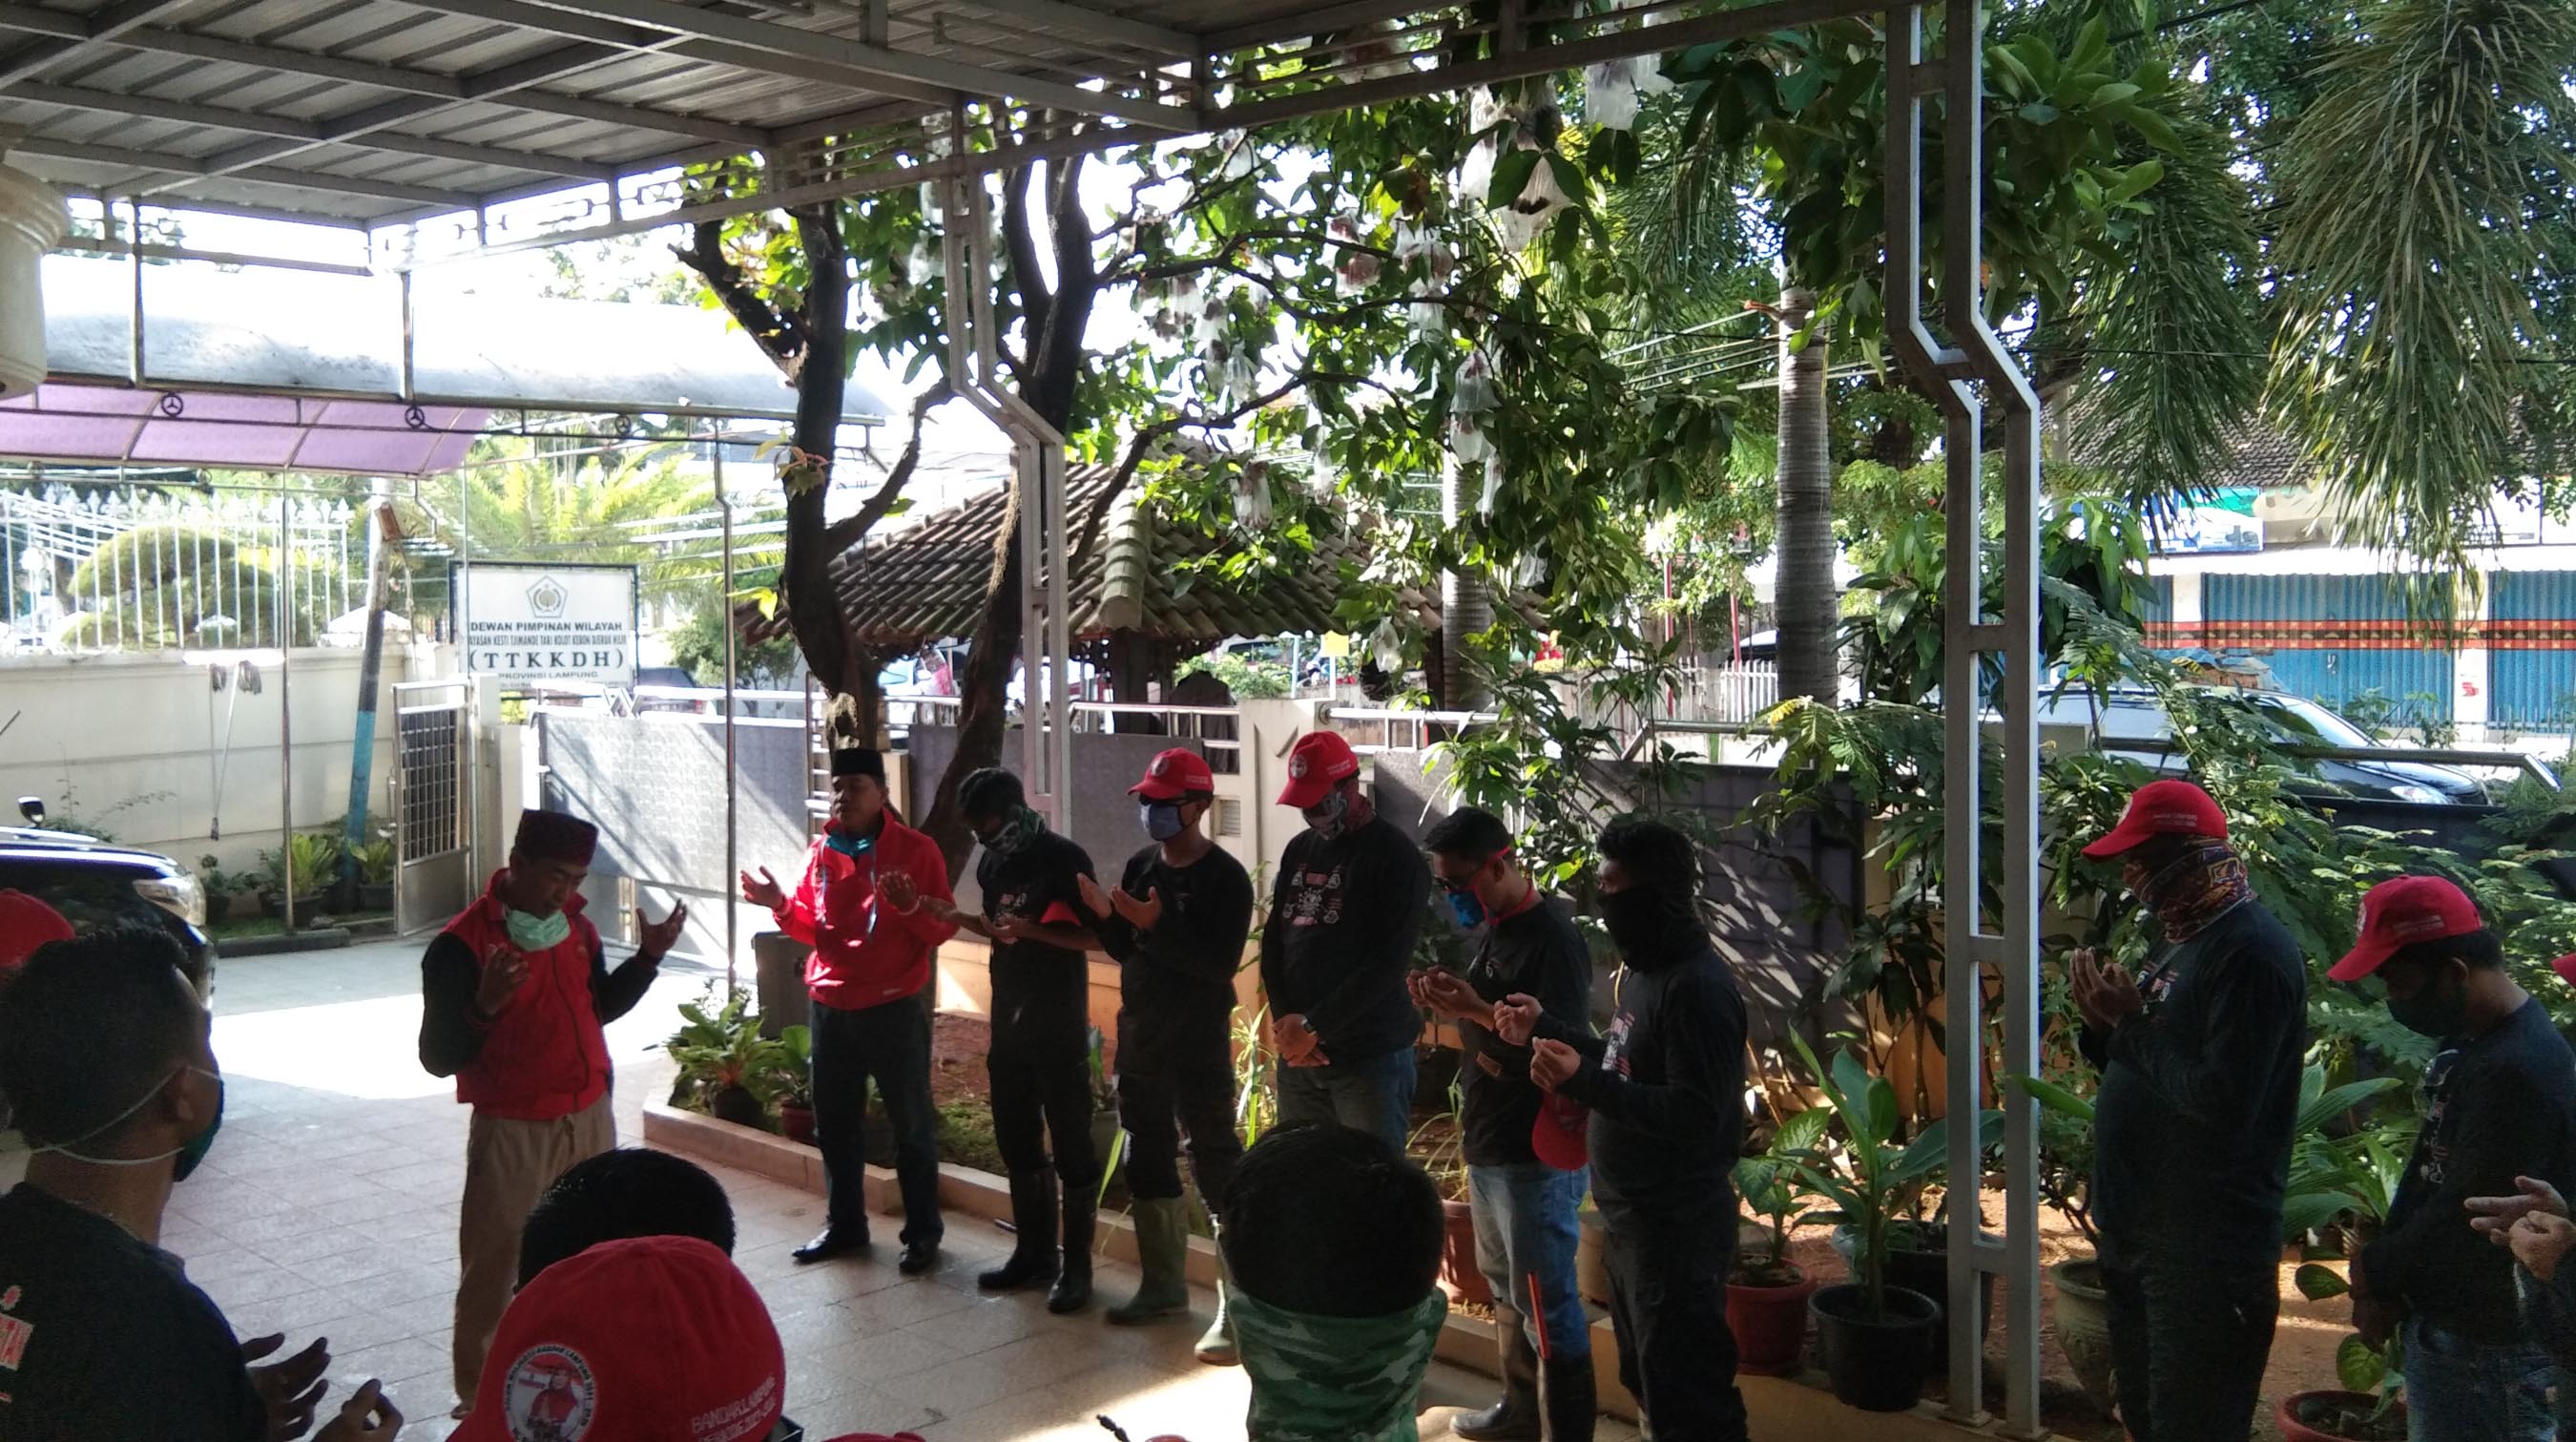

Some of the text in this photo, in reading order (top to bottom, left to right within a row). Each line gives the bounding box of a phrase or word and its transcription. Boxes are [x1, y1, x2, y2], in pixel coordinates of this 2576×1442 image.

[470, 622, 622, 631] DEWAN PIMPINAN WILAYAH
